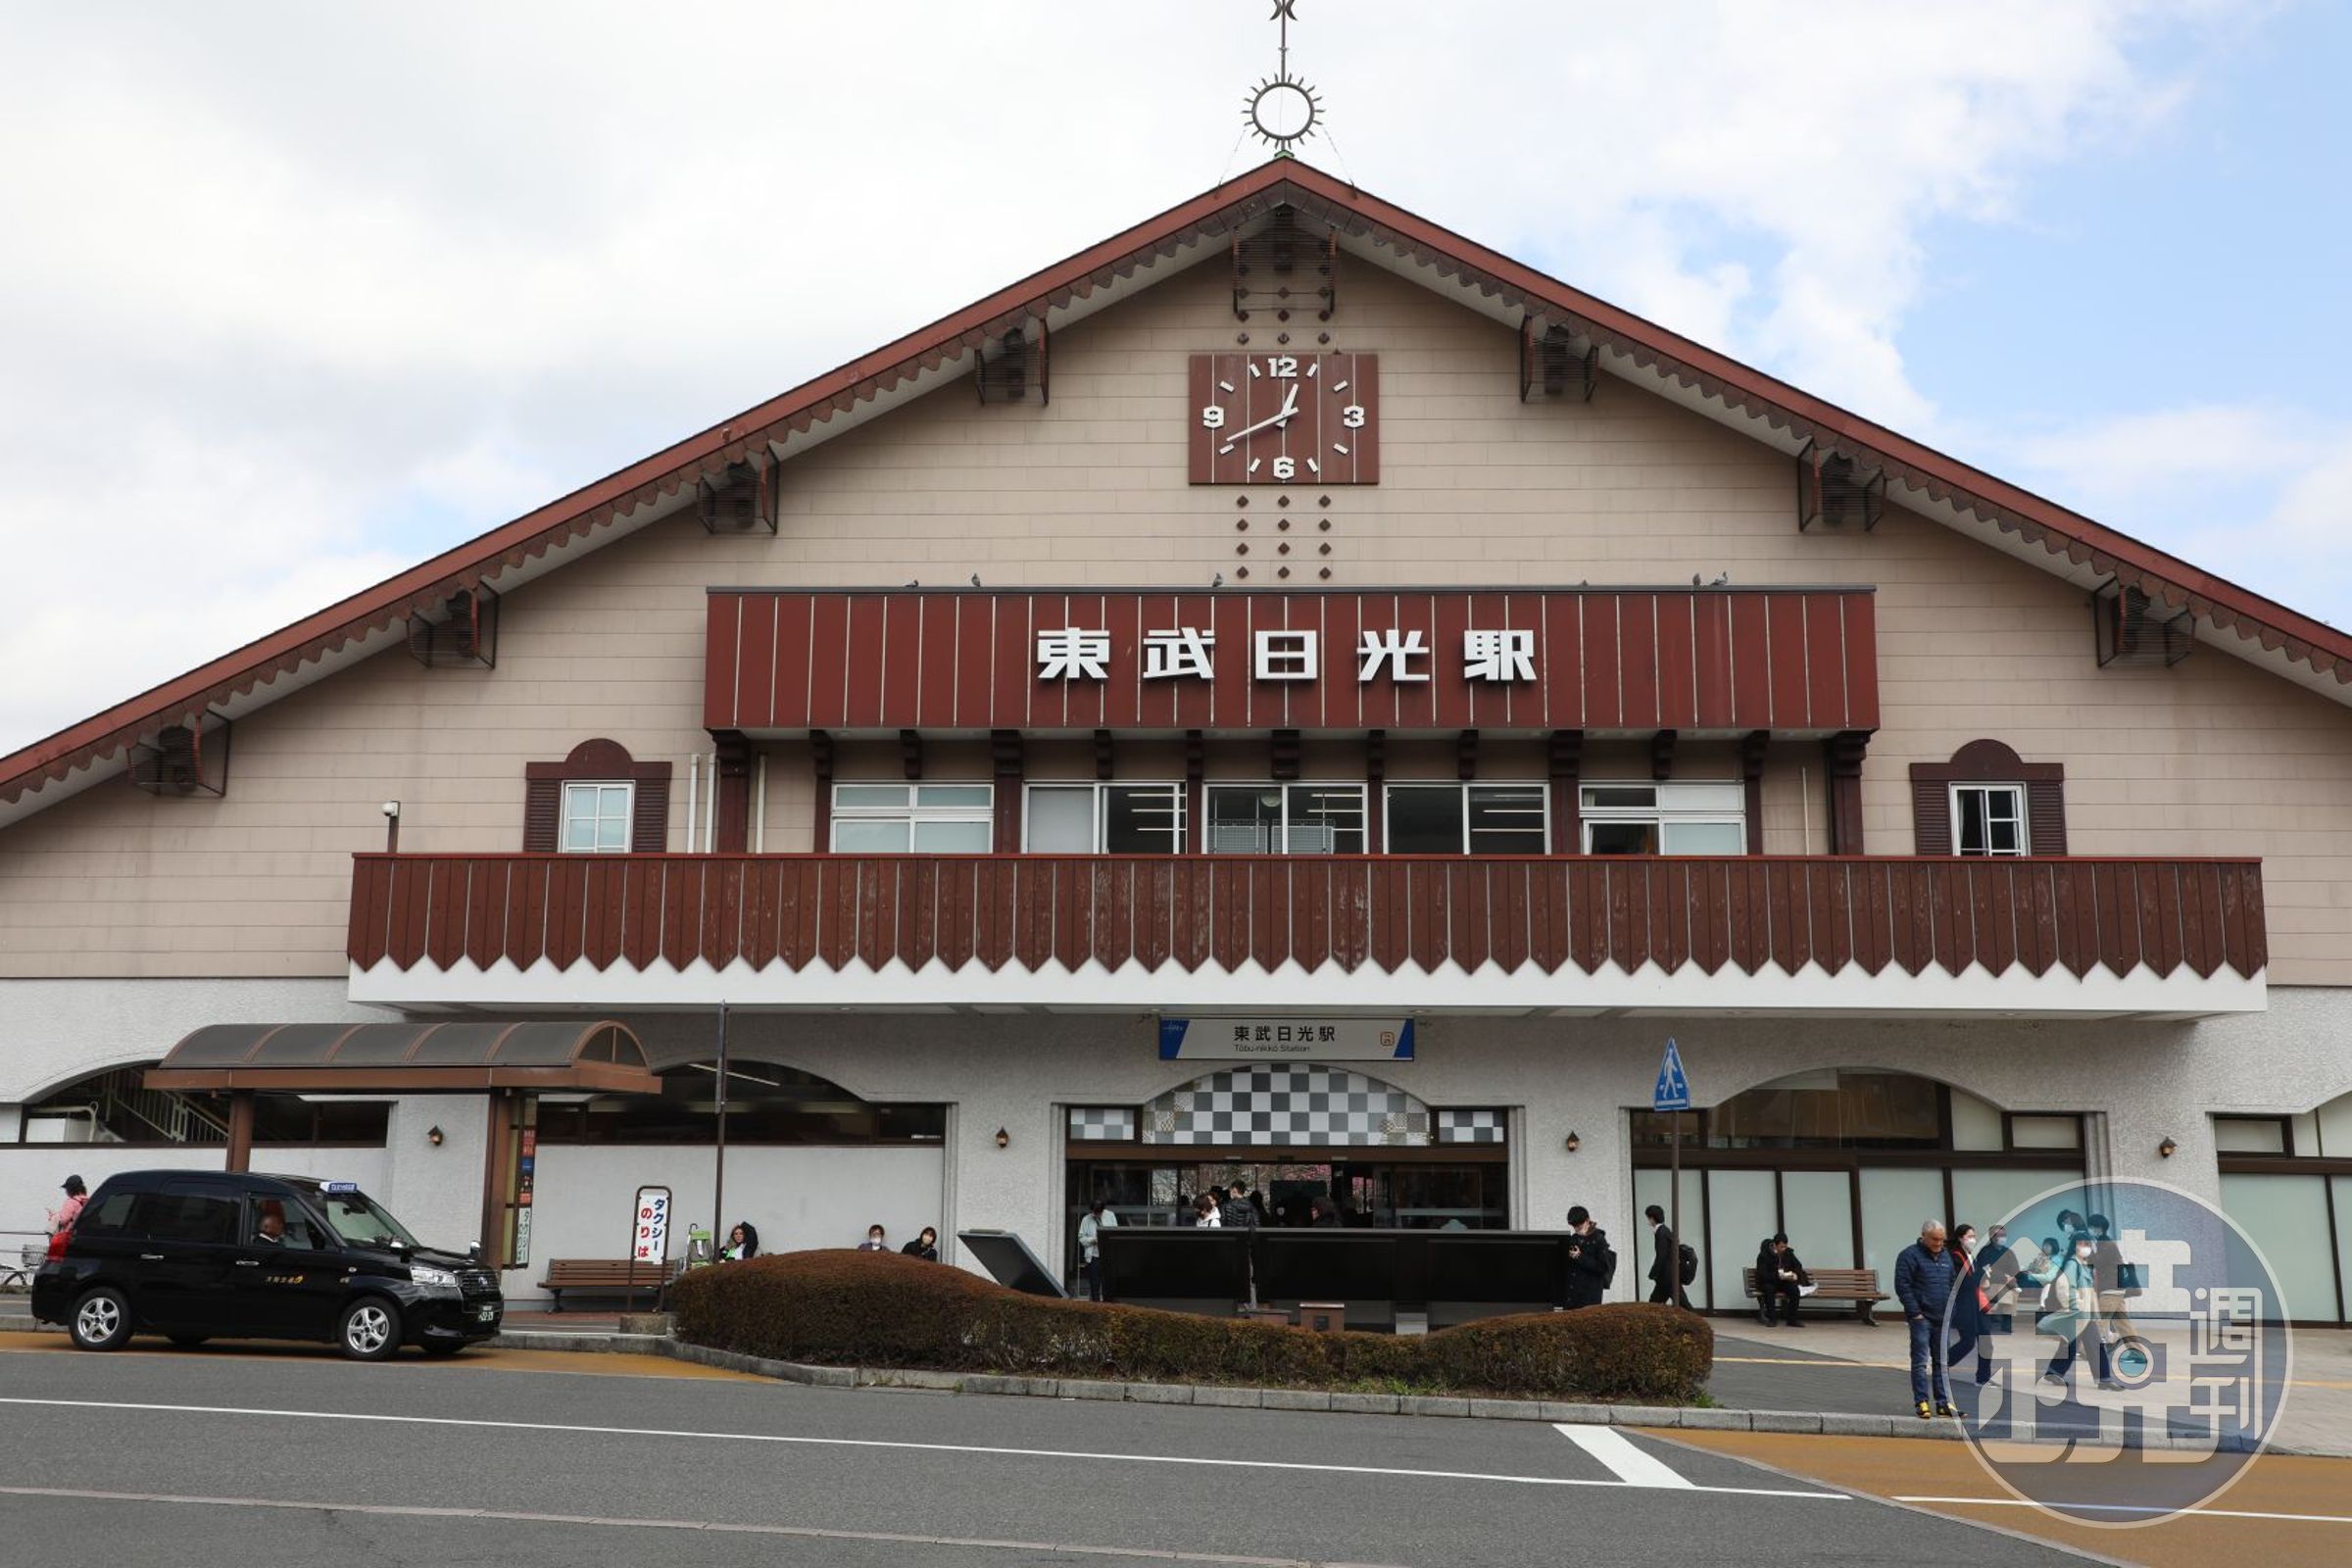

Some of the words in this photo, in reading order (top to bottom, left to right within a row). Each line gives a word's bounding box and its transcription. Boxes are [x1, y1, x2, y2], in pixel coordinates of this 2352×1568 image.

[1267, 357, 1298, 378] 12
[1202, 405, 1224, 428] 9
[1343, 405, 1365, 428] 3
[1273, 456, 1295, 479] 6
[1036, 626, 1538, 682] 東武日光駅
[1234, 1025, 1336, 1043] 東武日光駅
[638, 1207, 653, 1258] のりば
[652, 1199, 665, 1250] タクシー
